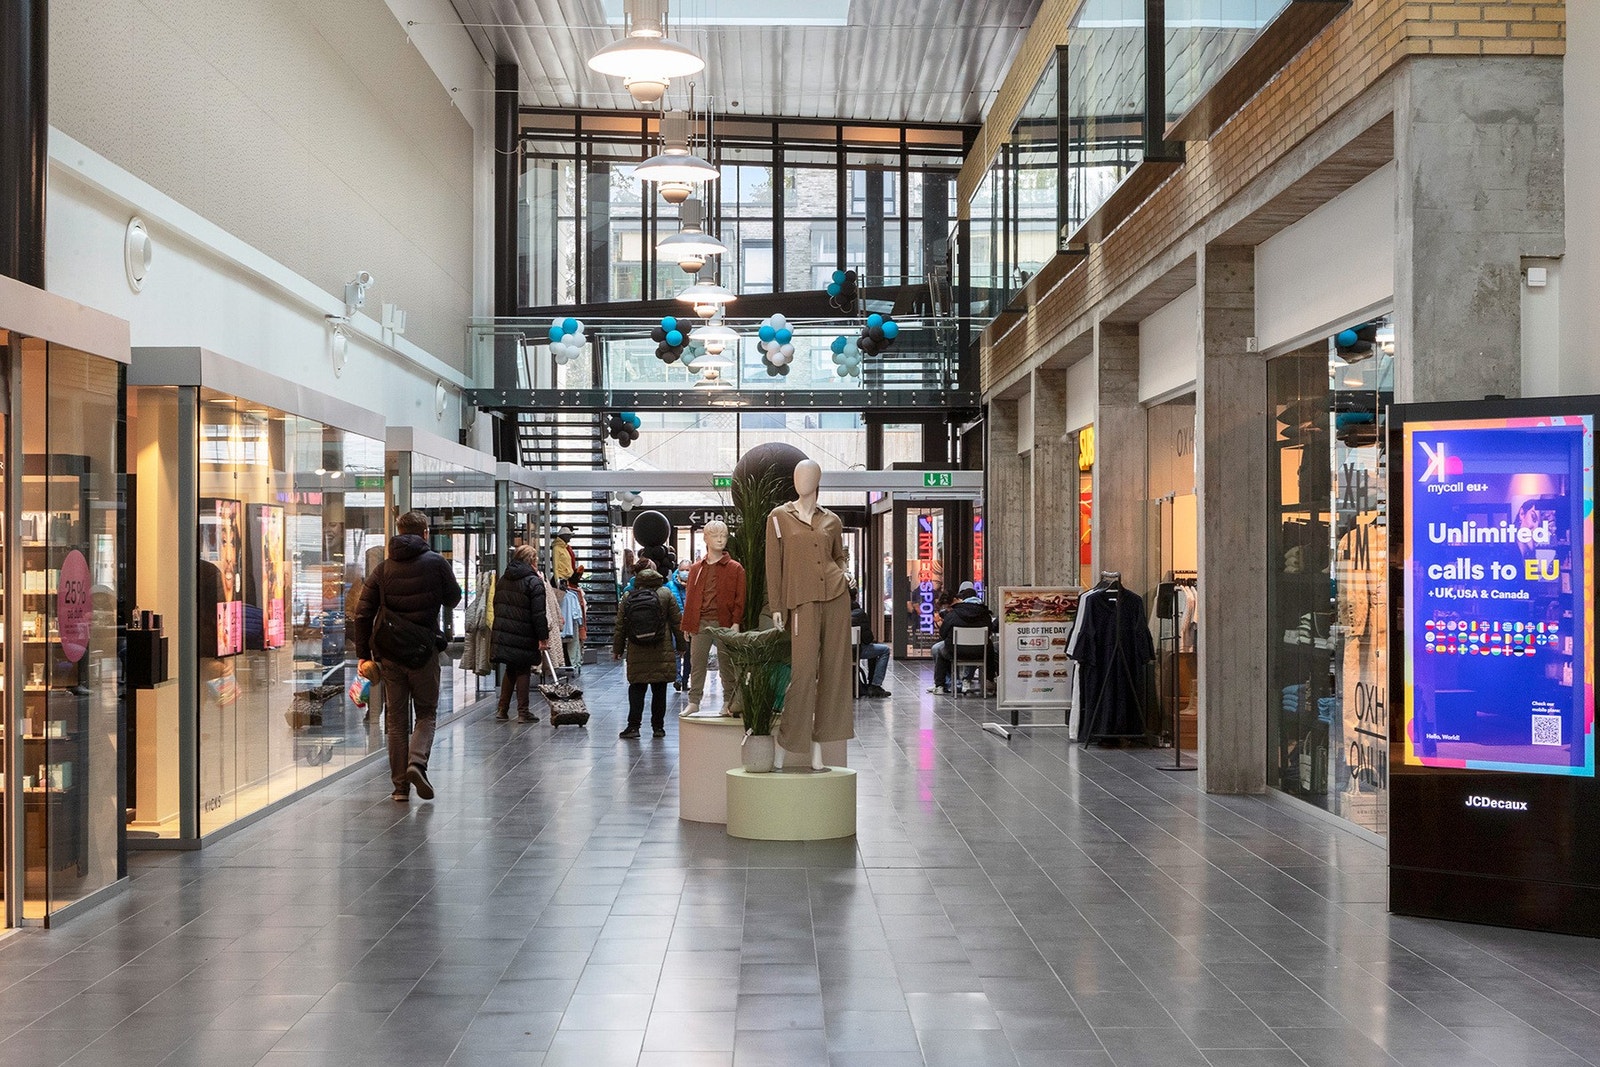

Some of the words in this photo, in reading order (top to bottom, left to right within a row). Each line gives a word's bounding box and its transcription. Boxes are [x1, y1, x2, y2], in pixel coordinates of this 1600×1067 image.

[1427, 482, 1464, 495] mycall
[1466, 483, 1489, 492] eu+
[1428, 520, 1550, 544] Unlimited
[1428, 557, 1485, 580] calls
[1490, 561, 1518, 580] to
[1524, 559, 1560, 580] EU
[64, 580, 87, 605] 25%
[919, 531, 935, 635] INTERSPORT
[1480, 590, 1489, 599] &
[1491, 590, 1530, 600] Canada
[1017, 627, 1030, 635] SUB
[1031, 627, 1040, 635] OF
[1041, 626, 1053, 634] THE
[1053, 626, 1067, 634] DAY
[1464, 795, 1528, 811] JCDecaux
